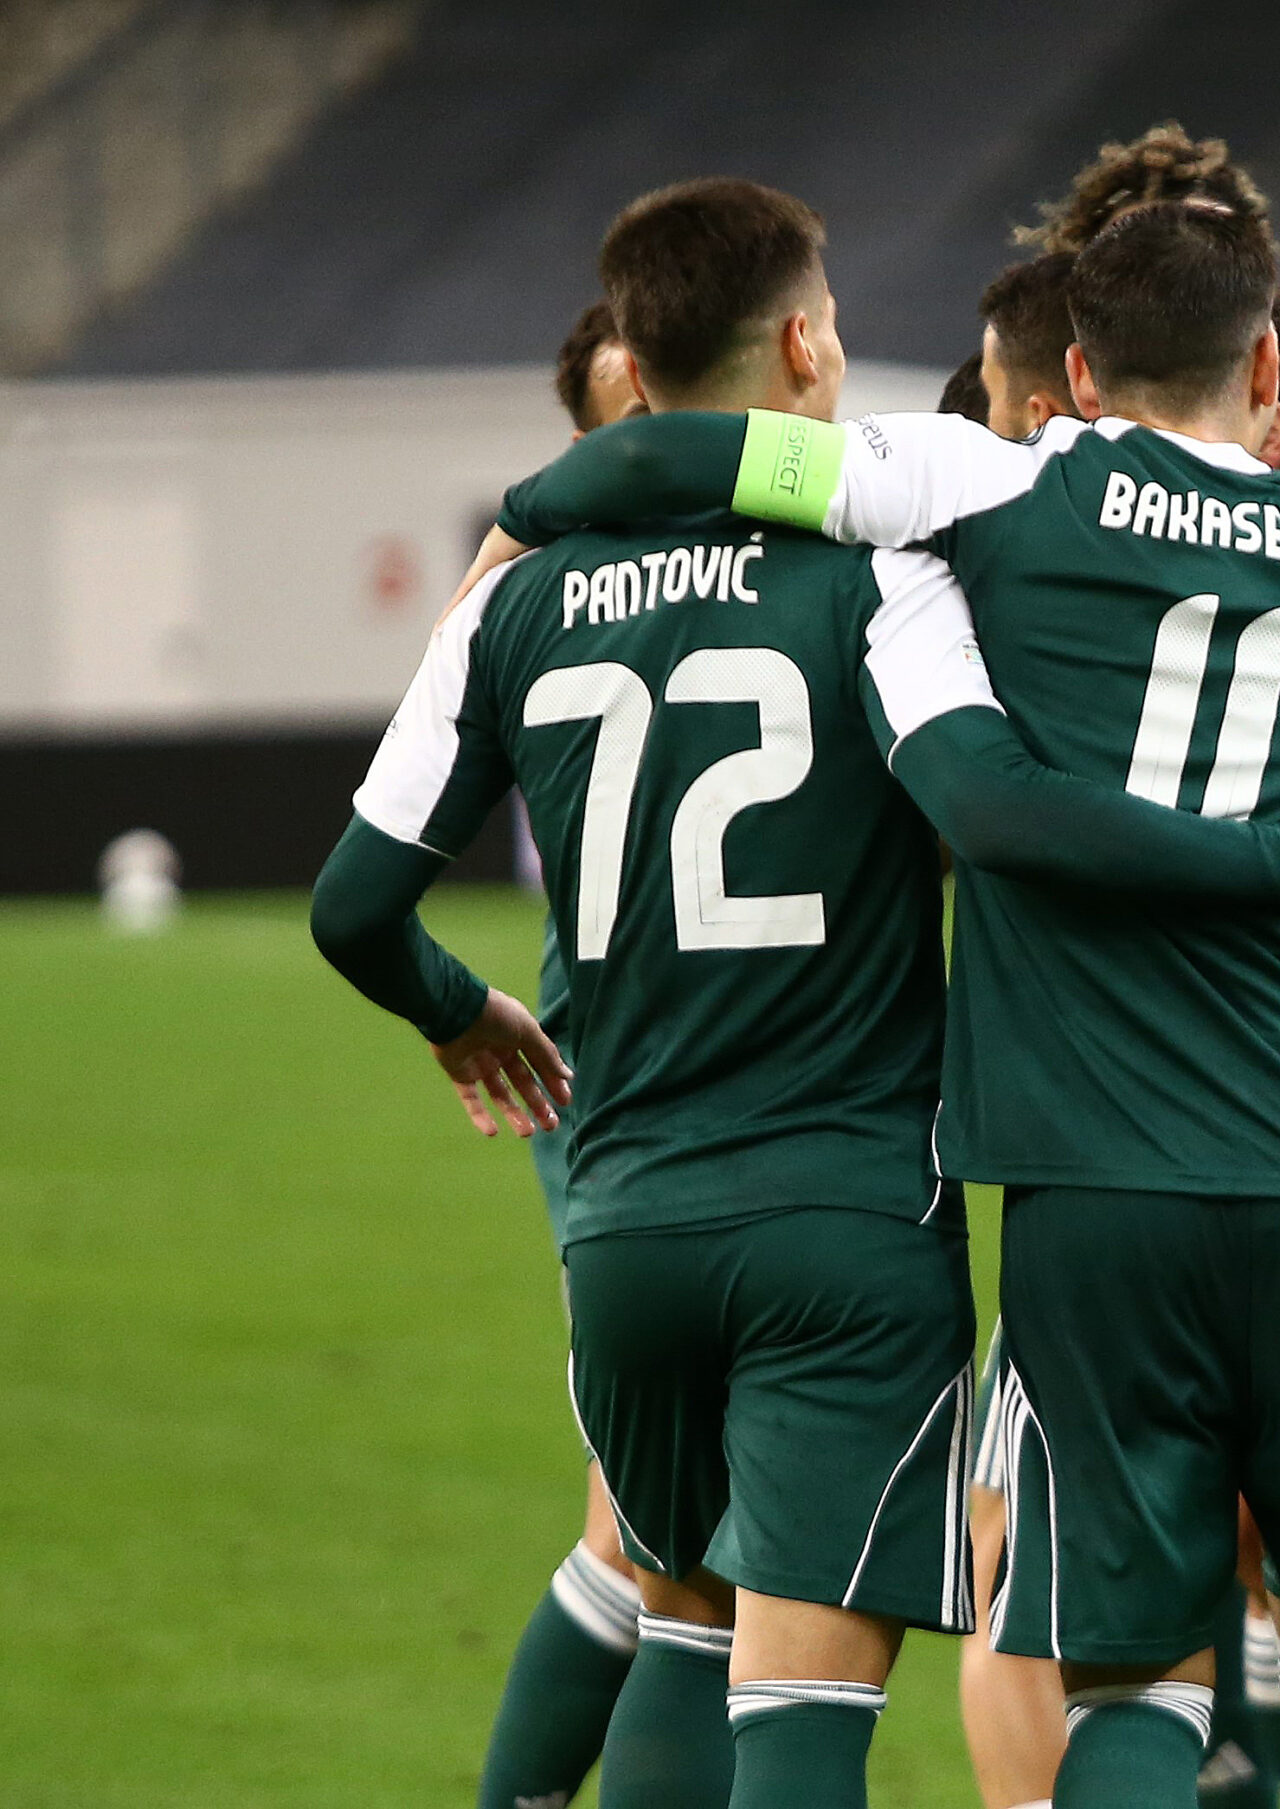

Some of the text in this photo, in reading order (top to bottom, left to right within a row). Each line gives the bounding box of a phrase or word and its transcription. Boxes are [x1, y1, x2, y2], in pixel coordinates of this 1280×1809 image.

[778, 417, 808, 496] ESPECT
[562, 531, 764, 629] PANTOVIĆ
[523, 647, 826, 960] 72
